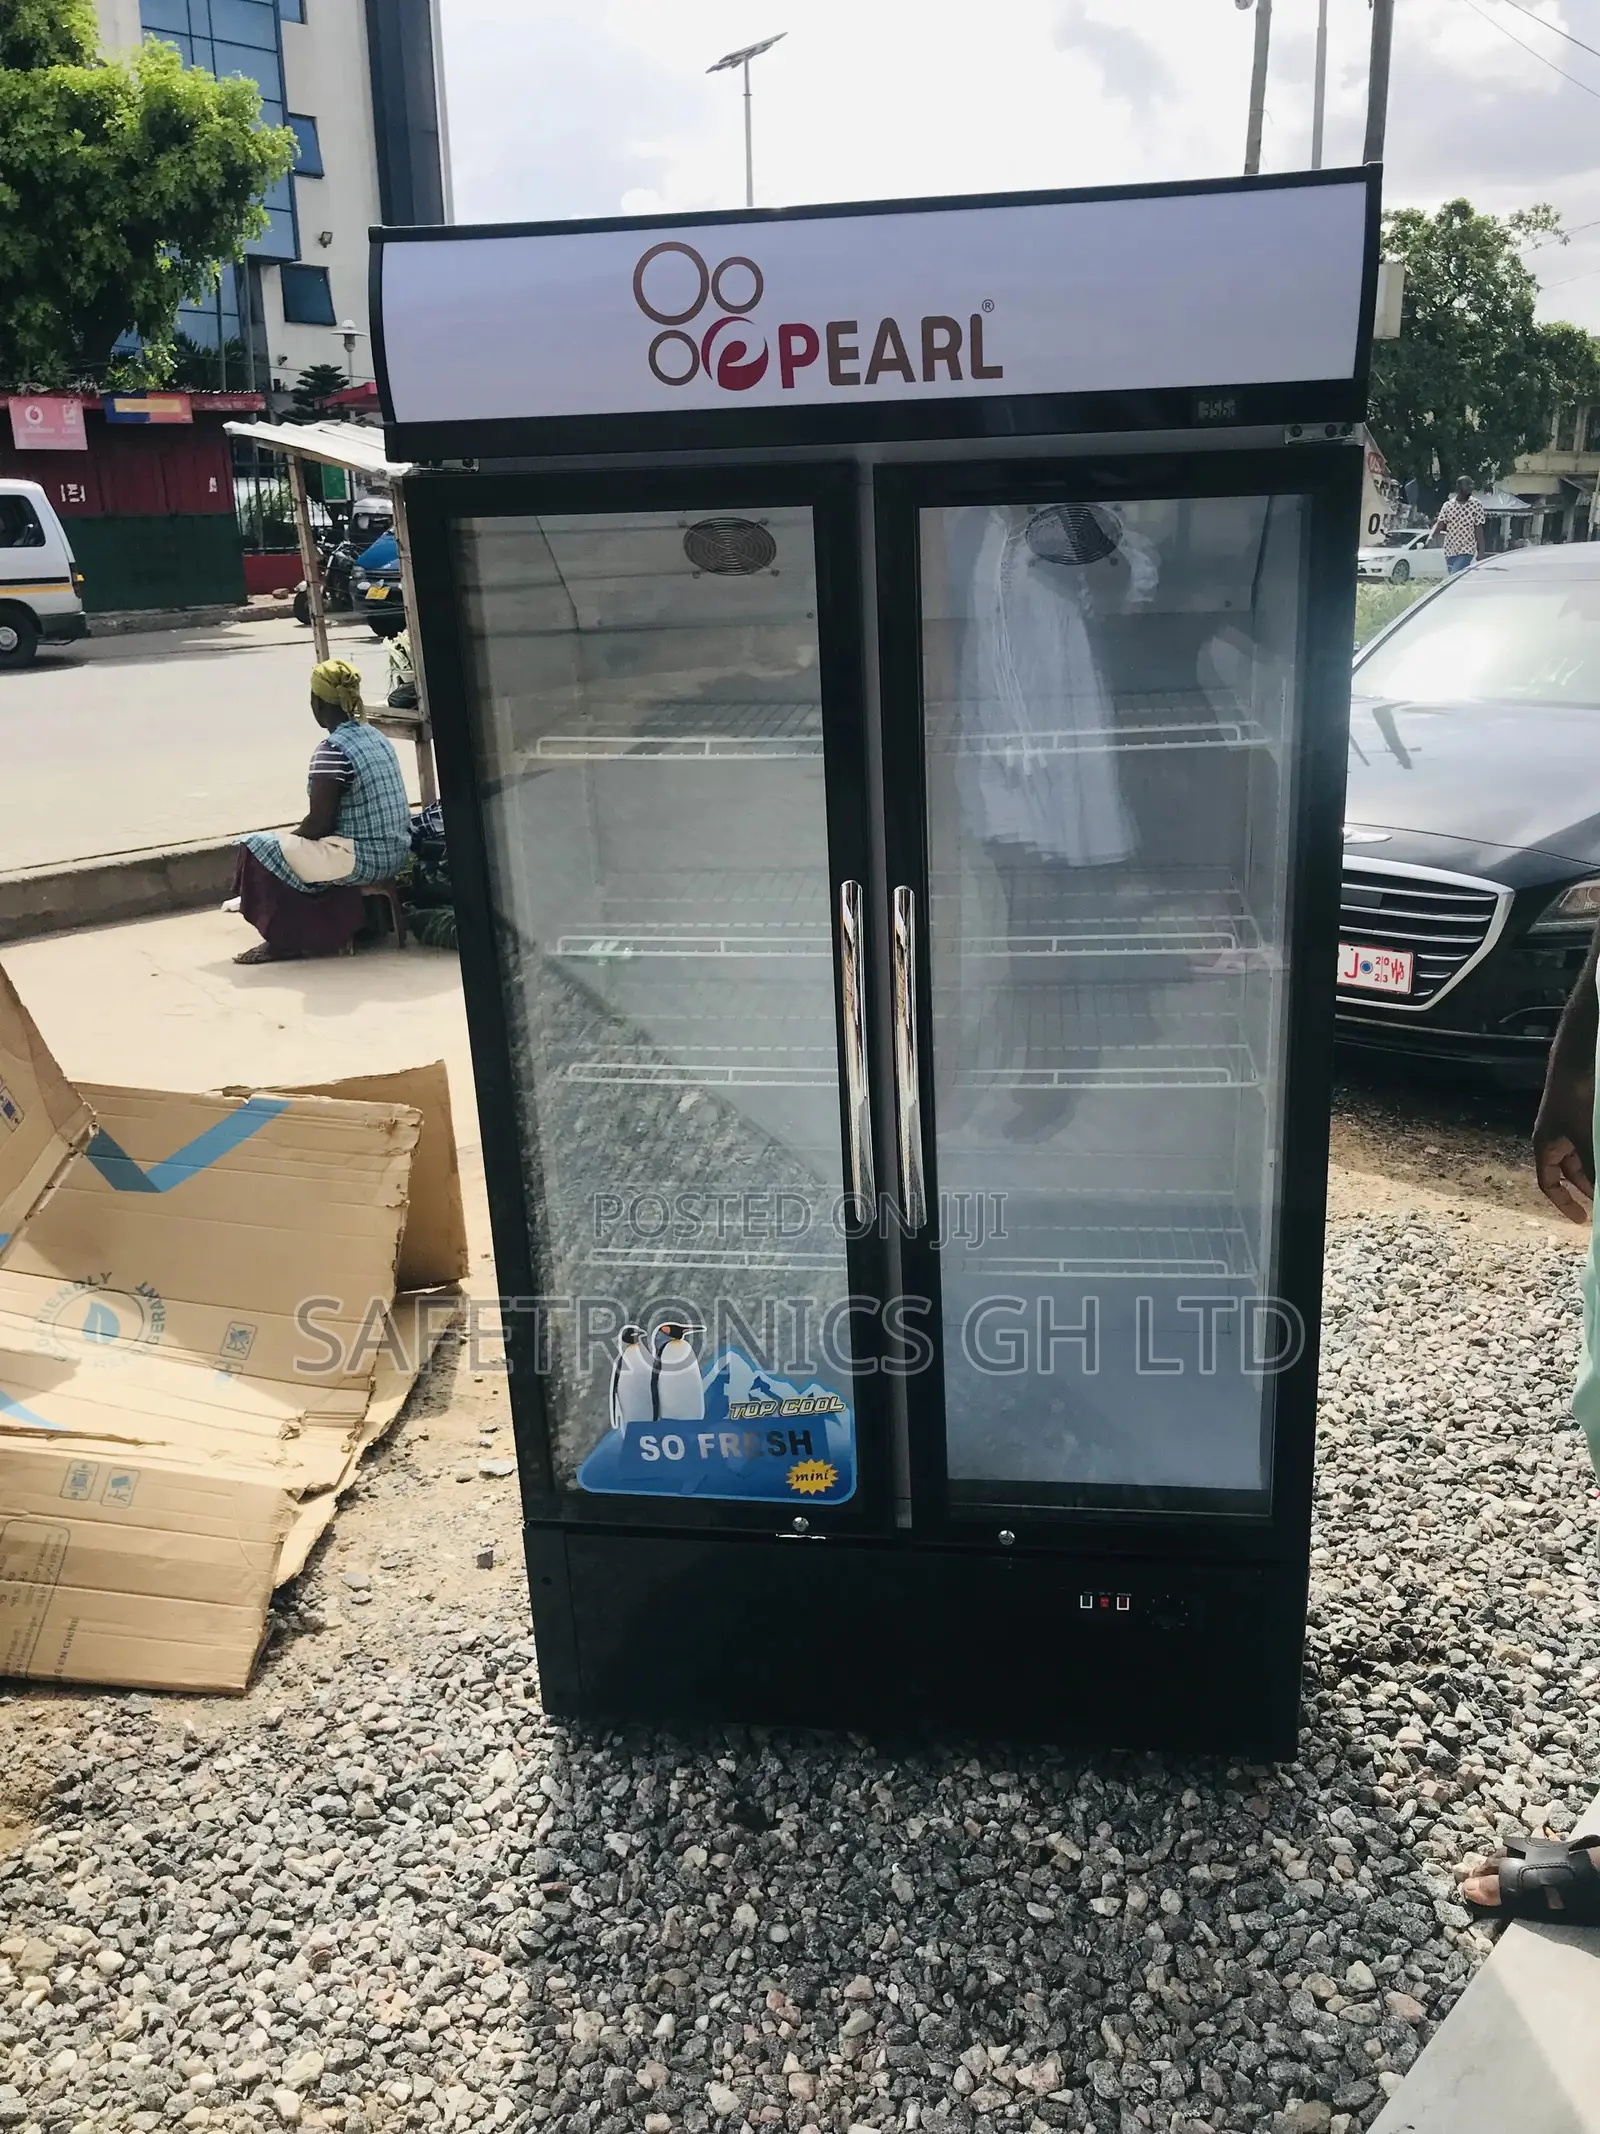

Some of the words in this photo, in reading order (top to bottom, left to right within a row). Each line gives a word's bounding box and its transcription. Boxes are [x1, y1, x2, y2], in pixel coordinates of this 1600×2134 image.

[778, 313, 1004, 389] PEARL
[730, 1400, 778, 1420] TOP
[780, 1395, 846, 1417] COOL
[639, 1433, 686, 1462] SO
[697, 1429, 814, 1460] FRESH
[794, 1468, 829, 1483] mini
